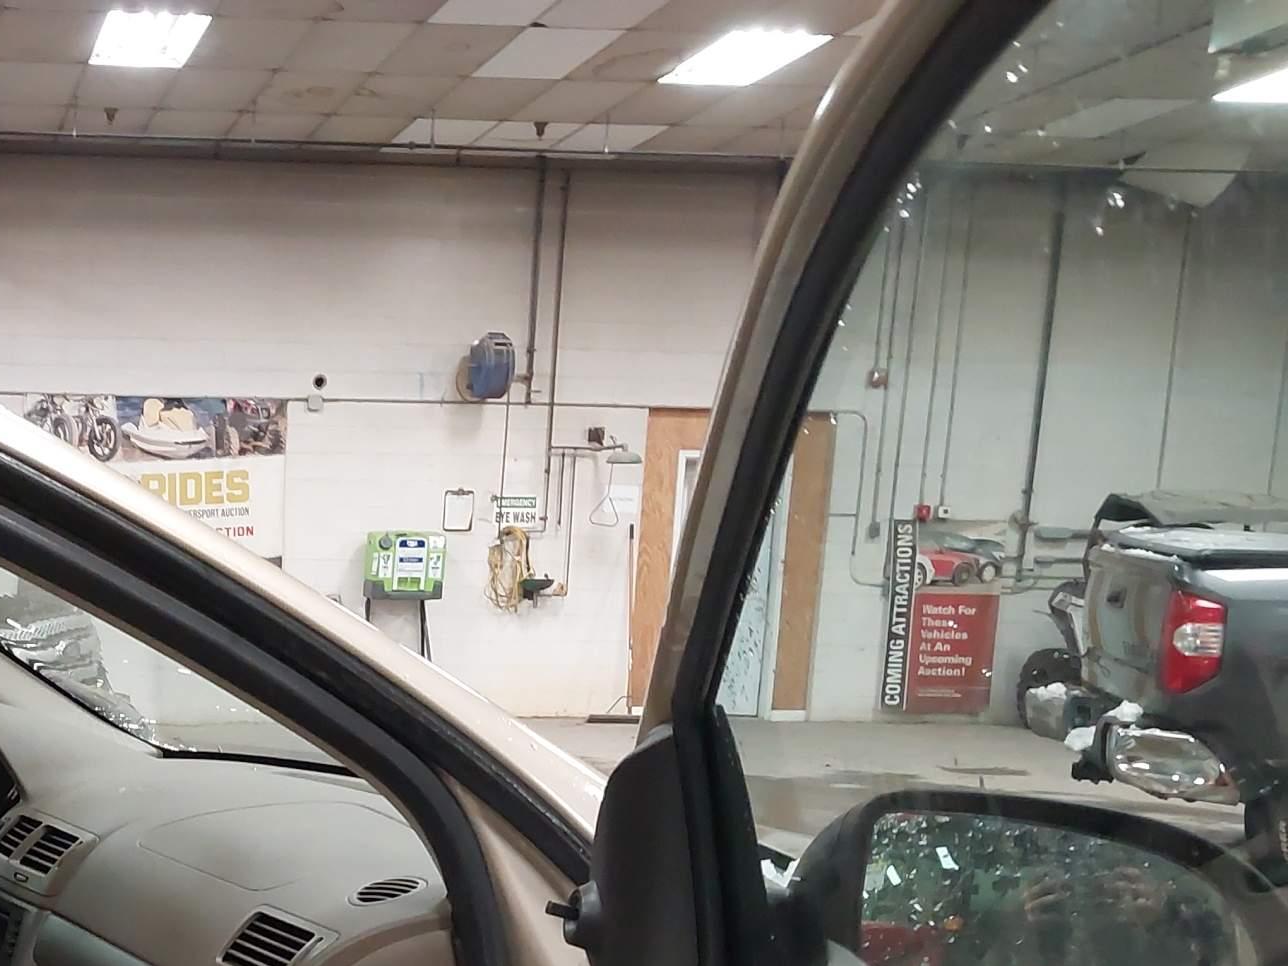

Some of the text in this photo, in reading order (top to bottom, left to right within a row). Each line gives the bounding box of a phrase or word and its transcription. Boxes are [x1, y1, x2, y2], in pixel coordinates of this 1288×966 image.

[139, 470, 250, 506] RIDES
[220, 506, 250, 518] AUCTION
[495, 511, 536, 523] EYE WASH
[884, 523, 914, 706] COMING ATTRACTIONS
[922, 604, 976, 616] Watch For
[921, 617, 954, 628] Thes
[920, 629, 968, 640] Vehicles
[919, 642, 951, 652] At An
[918, 654, 972, 666] Upcoming
[917, 666, 965, 677] Auction!
